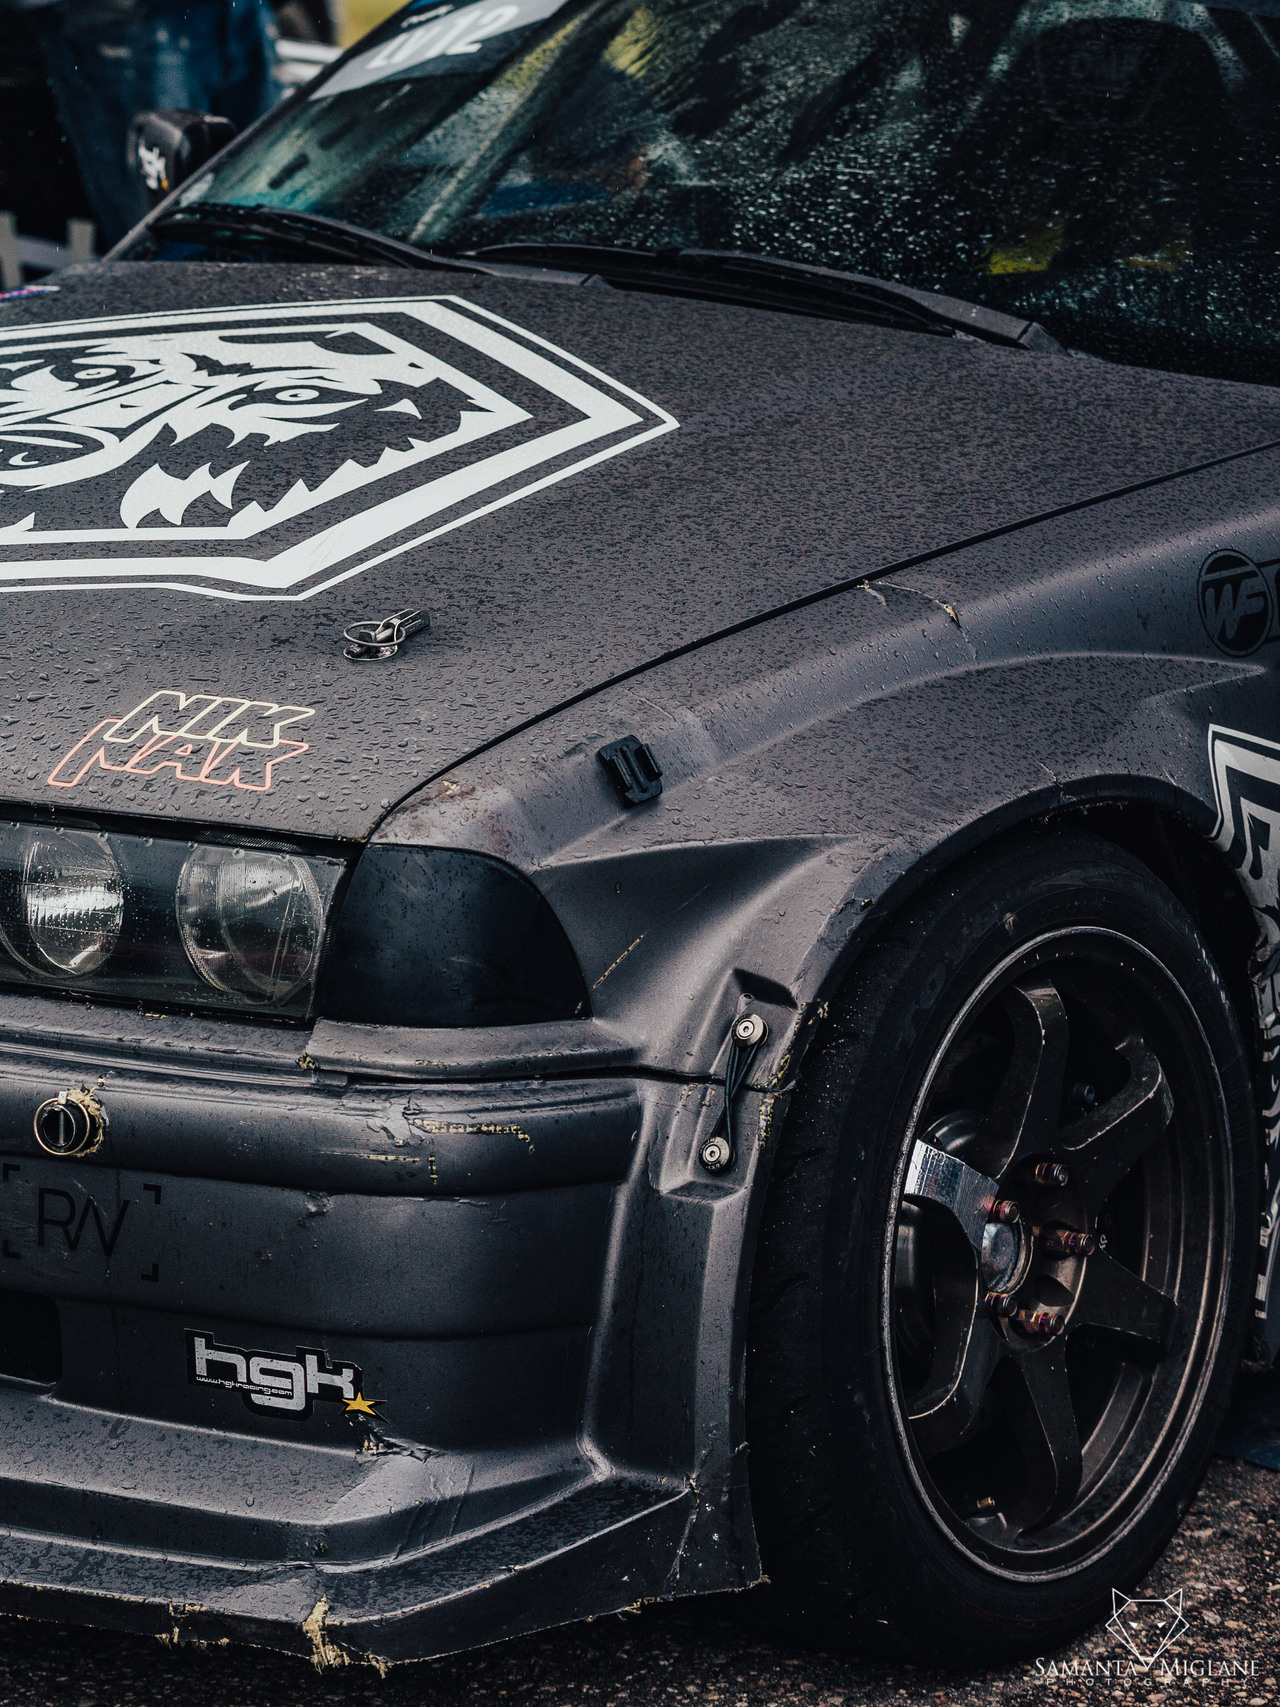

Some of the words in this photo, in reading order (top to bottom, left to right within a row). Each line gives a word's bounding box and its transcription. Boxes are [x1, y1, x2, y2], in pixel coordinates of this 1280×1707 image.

[47, 718, 309, 792] NAK
[103, 690, 315, 748] NIK
[194, 1336, 355, 1411] hgk
